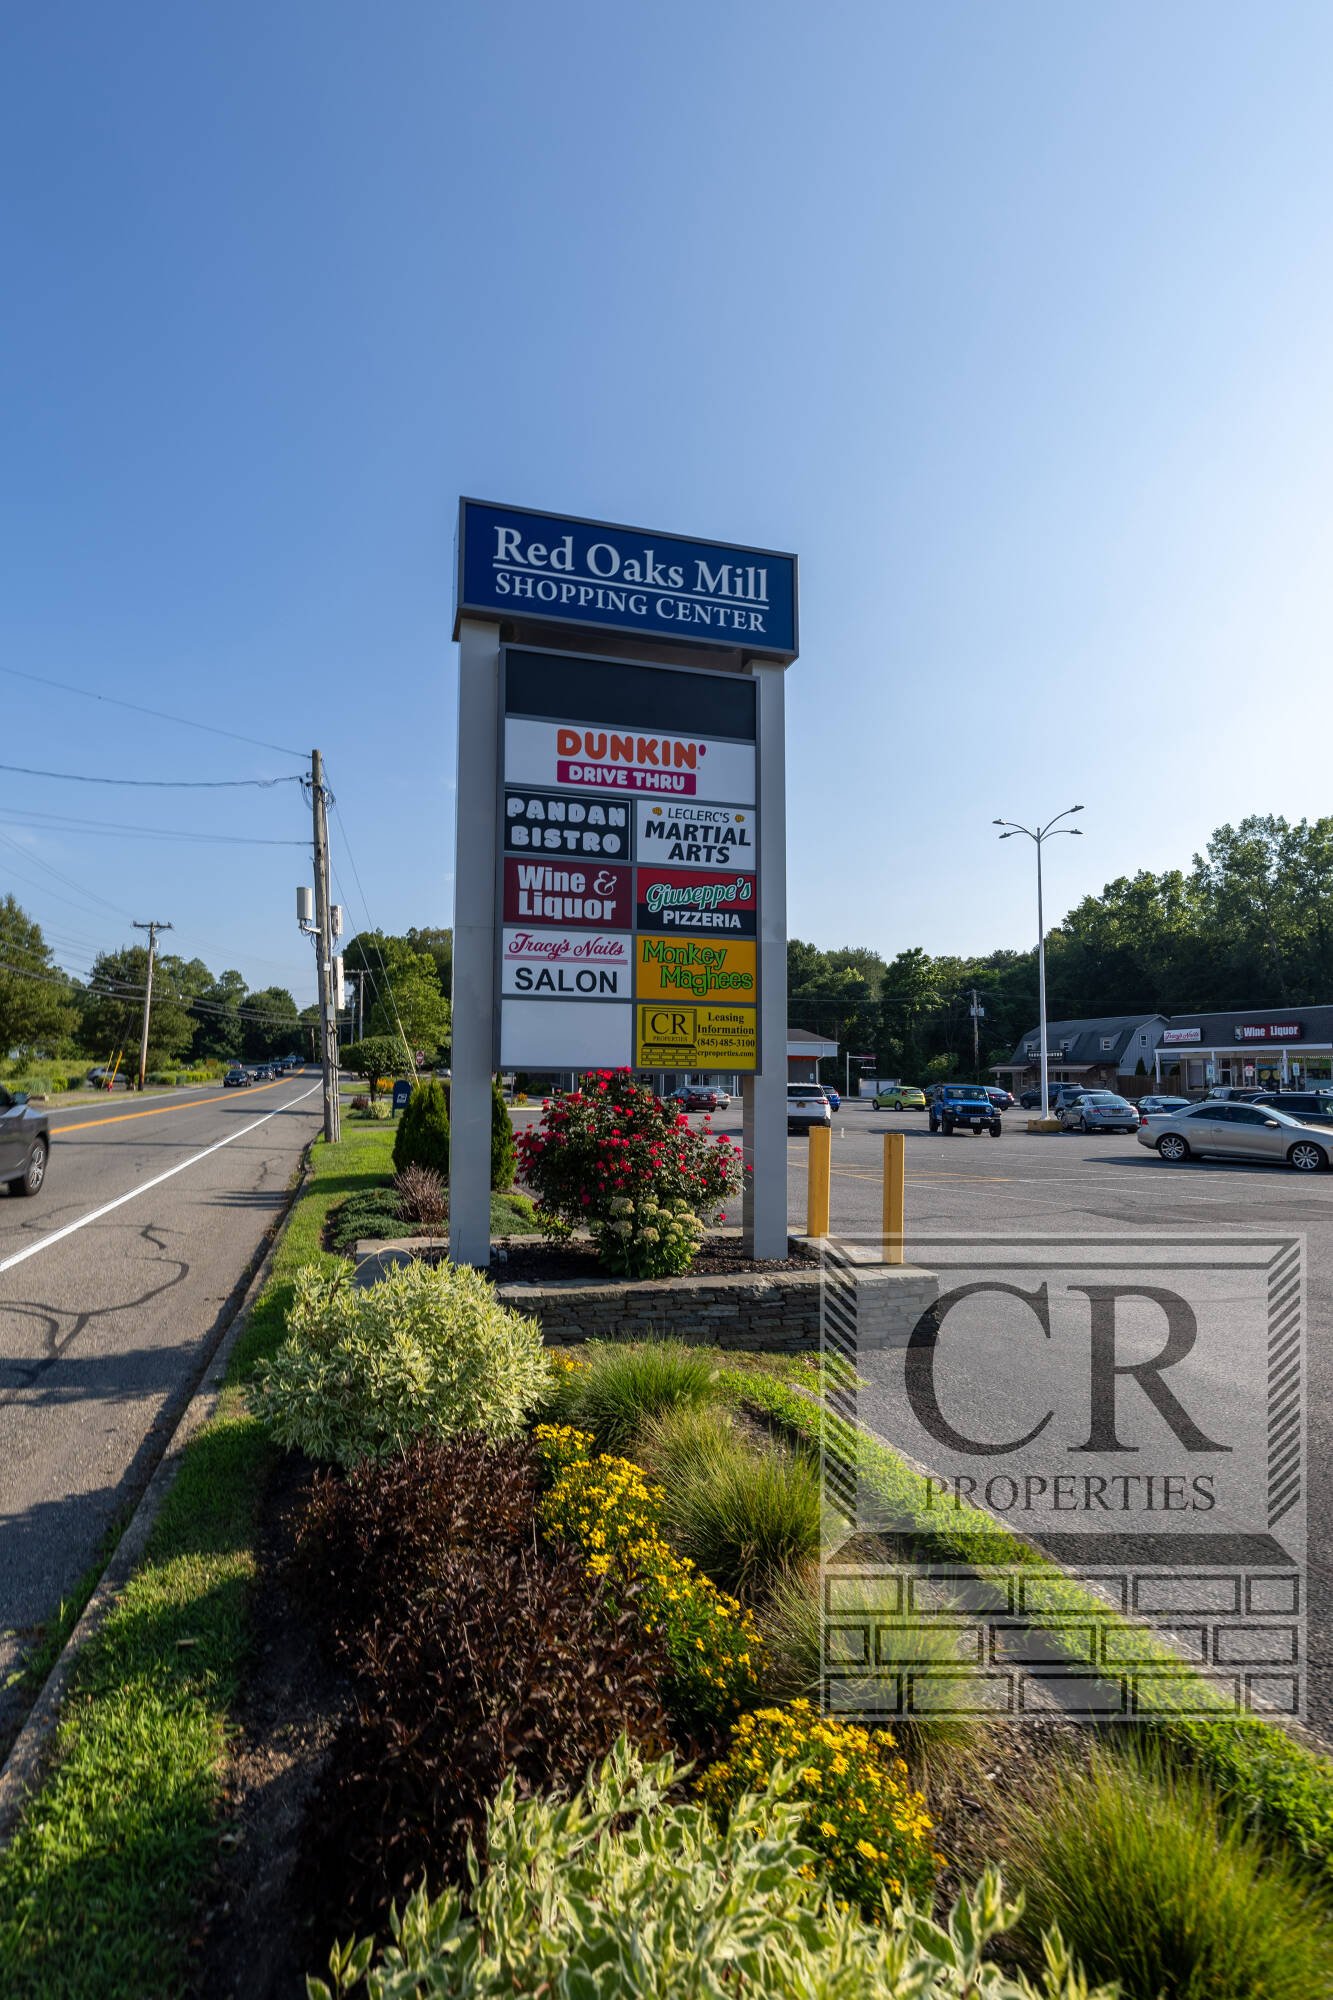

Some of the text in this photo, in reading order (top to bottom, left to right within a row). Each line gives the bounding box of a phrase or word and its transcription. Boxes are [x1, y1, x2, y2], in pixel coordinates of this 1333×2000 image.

[494, 525, 769, 602] Red Oaks Mill
[495, 572, 767, 632] SHOPPING CENTER
[557, 728, 706, 770] DUNKIN'
[569, 765, 685, 790] DRIVE THRU
[507, 798, 626, 827] PANDAN
[668, 807, 730, 823] LECLERC'S
[511, 826, 621, 853] BISTRO
[645, 820, 752, 846] MARTIAL
[668, 843, 730, 864] ARTS
[517, 865, 617, 896] Wine &
[518, 891, 616, 920] Liquor
[646, 878, 752, 913] Giuseppe's
[663, 910, 741, 928] PIZZERIA
[508, 933, 624, 960] Tracy's Nails
[642, 940, 728, 970] Monkey
[514, 967, 617, 993] SALON
[660, 966, 753, 996] Maghees
[651, 1012, 689, 1035] CR
[697, 1024, 754, 1035] Information
[708, 1012, 744, 1025] Leasing
[1244, 1025, 1298, 1037] Wine Liquor
[697, 1038, 756, 1048] (845) 485-3100
[697, 1049, 754, 1059] crproperties.com
